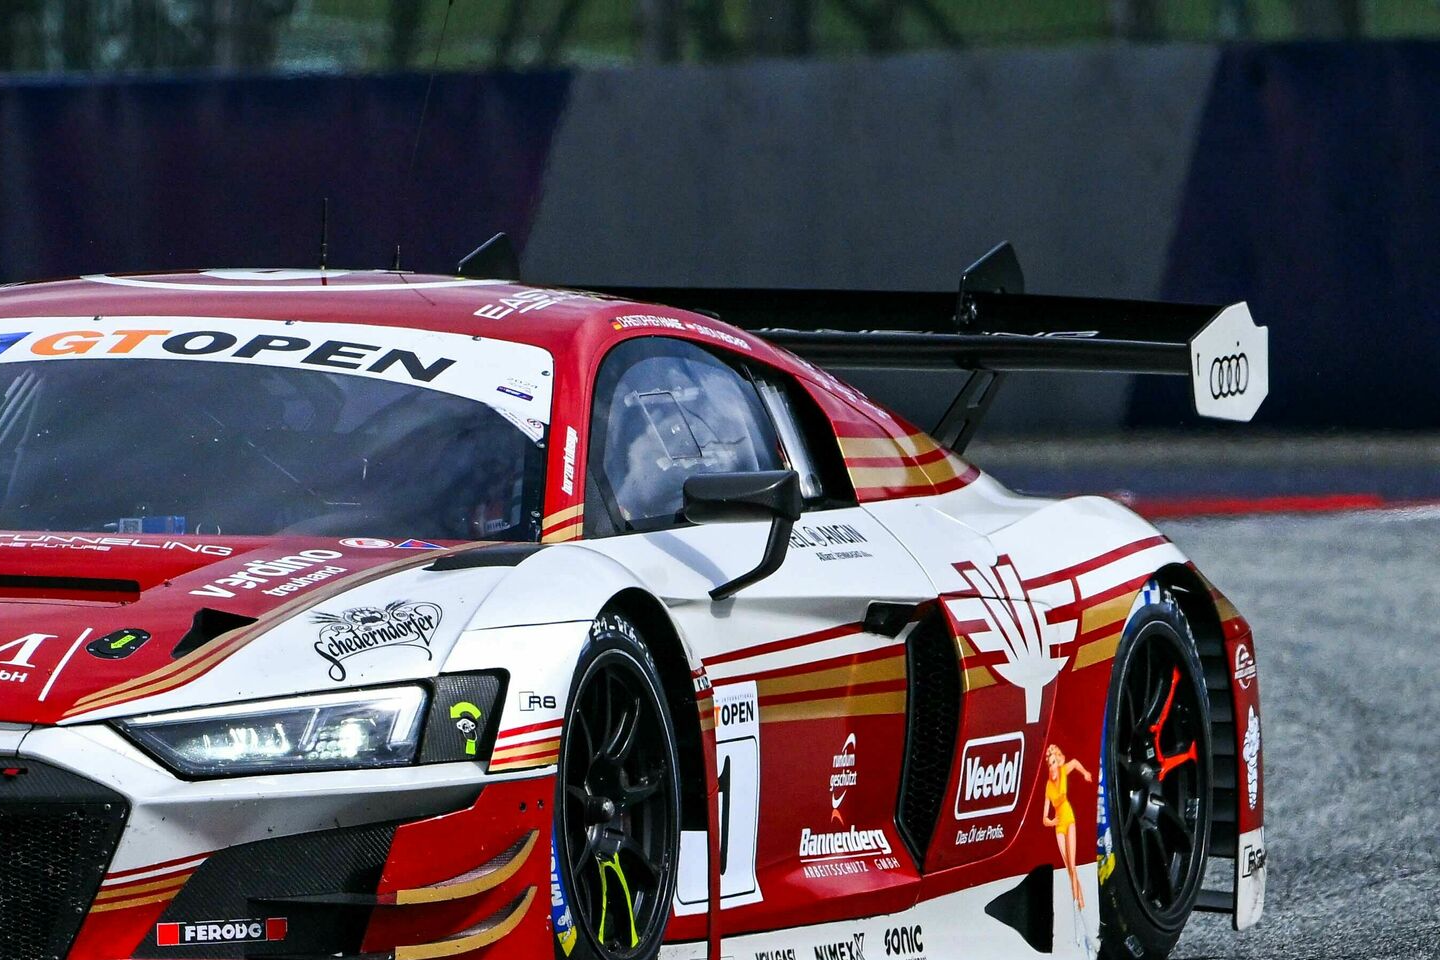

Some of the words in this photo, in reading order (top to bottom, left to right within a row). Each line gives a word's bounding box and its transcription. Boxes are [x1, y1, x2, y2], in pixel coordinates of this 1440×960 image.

[815, 524, 869, 545] ANGIN
[30, 542, 112, 552] FUTURE
[261, 564, 348, 599] treuhand
[529, 693, 557, 710] R8
[832, 749, 856, 769] rundum
[829, 768, 858, 792] geschützt
[964, 750, 1021, 801] Veedol
[799, 824, 893, 857] Bannenberg
[803, 861, 869, 878] ARBEITSSCHUTZ
[874, 857, 901, 870] GMBH
[184, 921, 262, 942] FERODO
